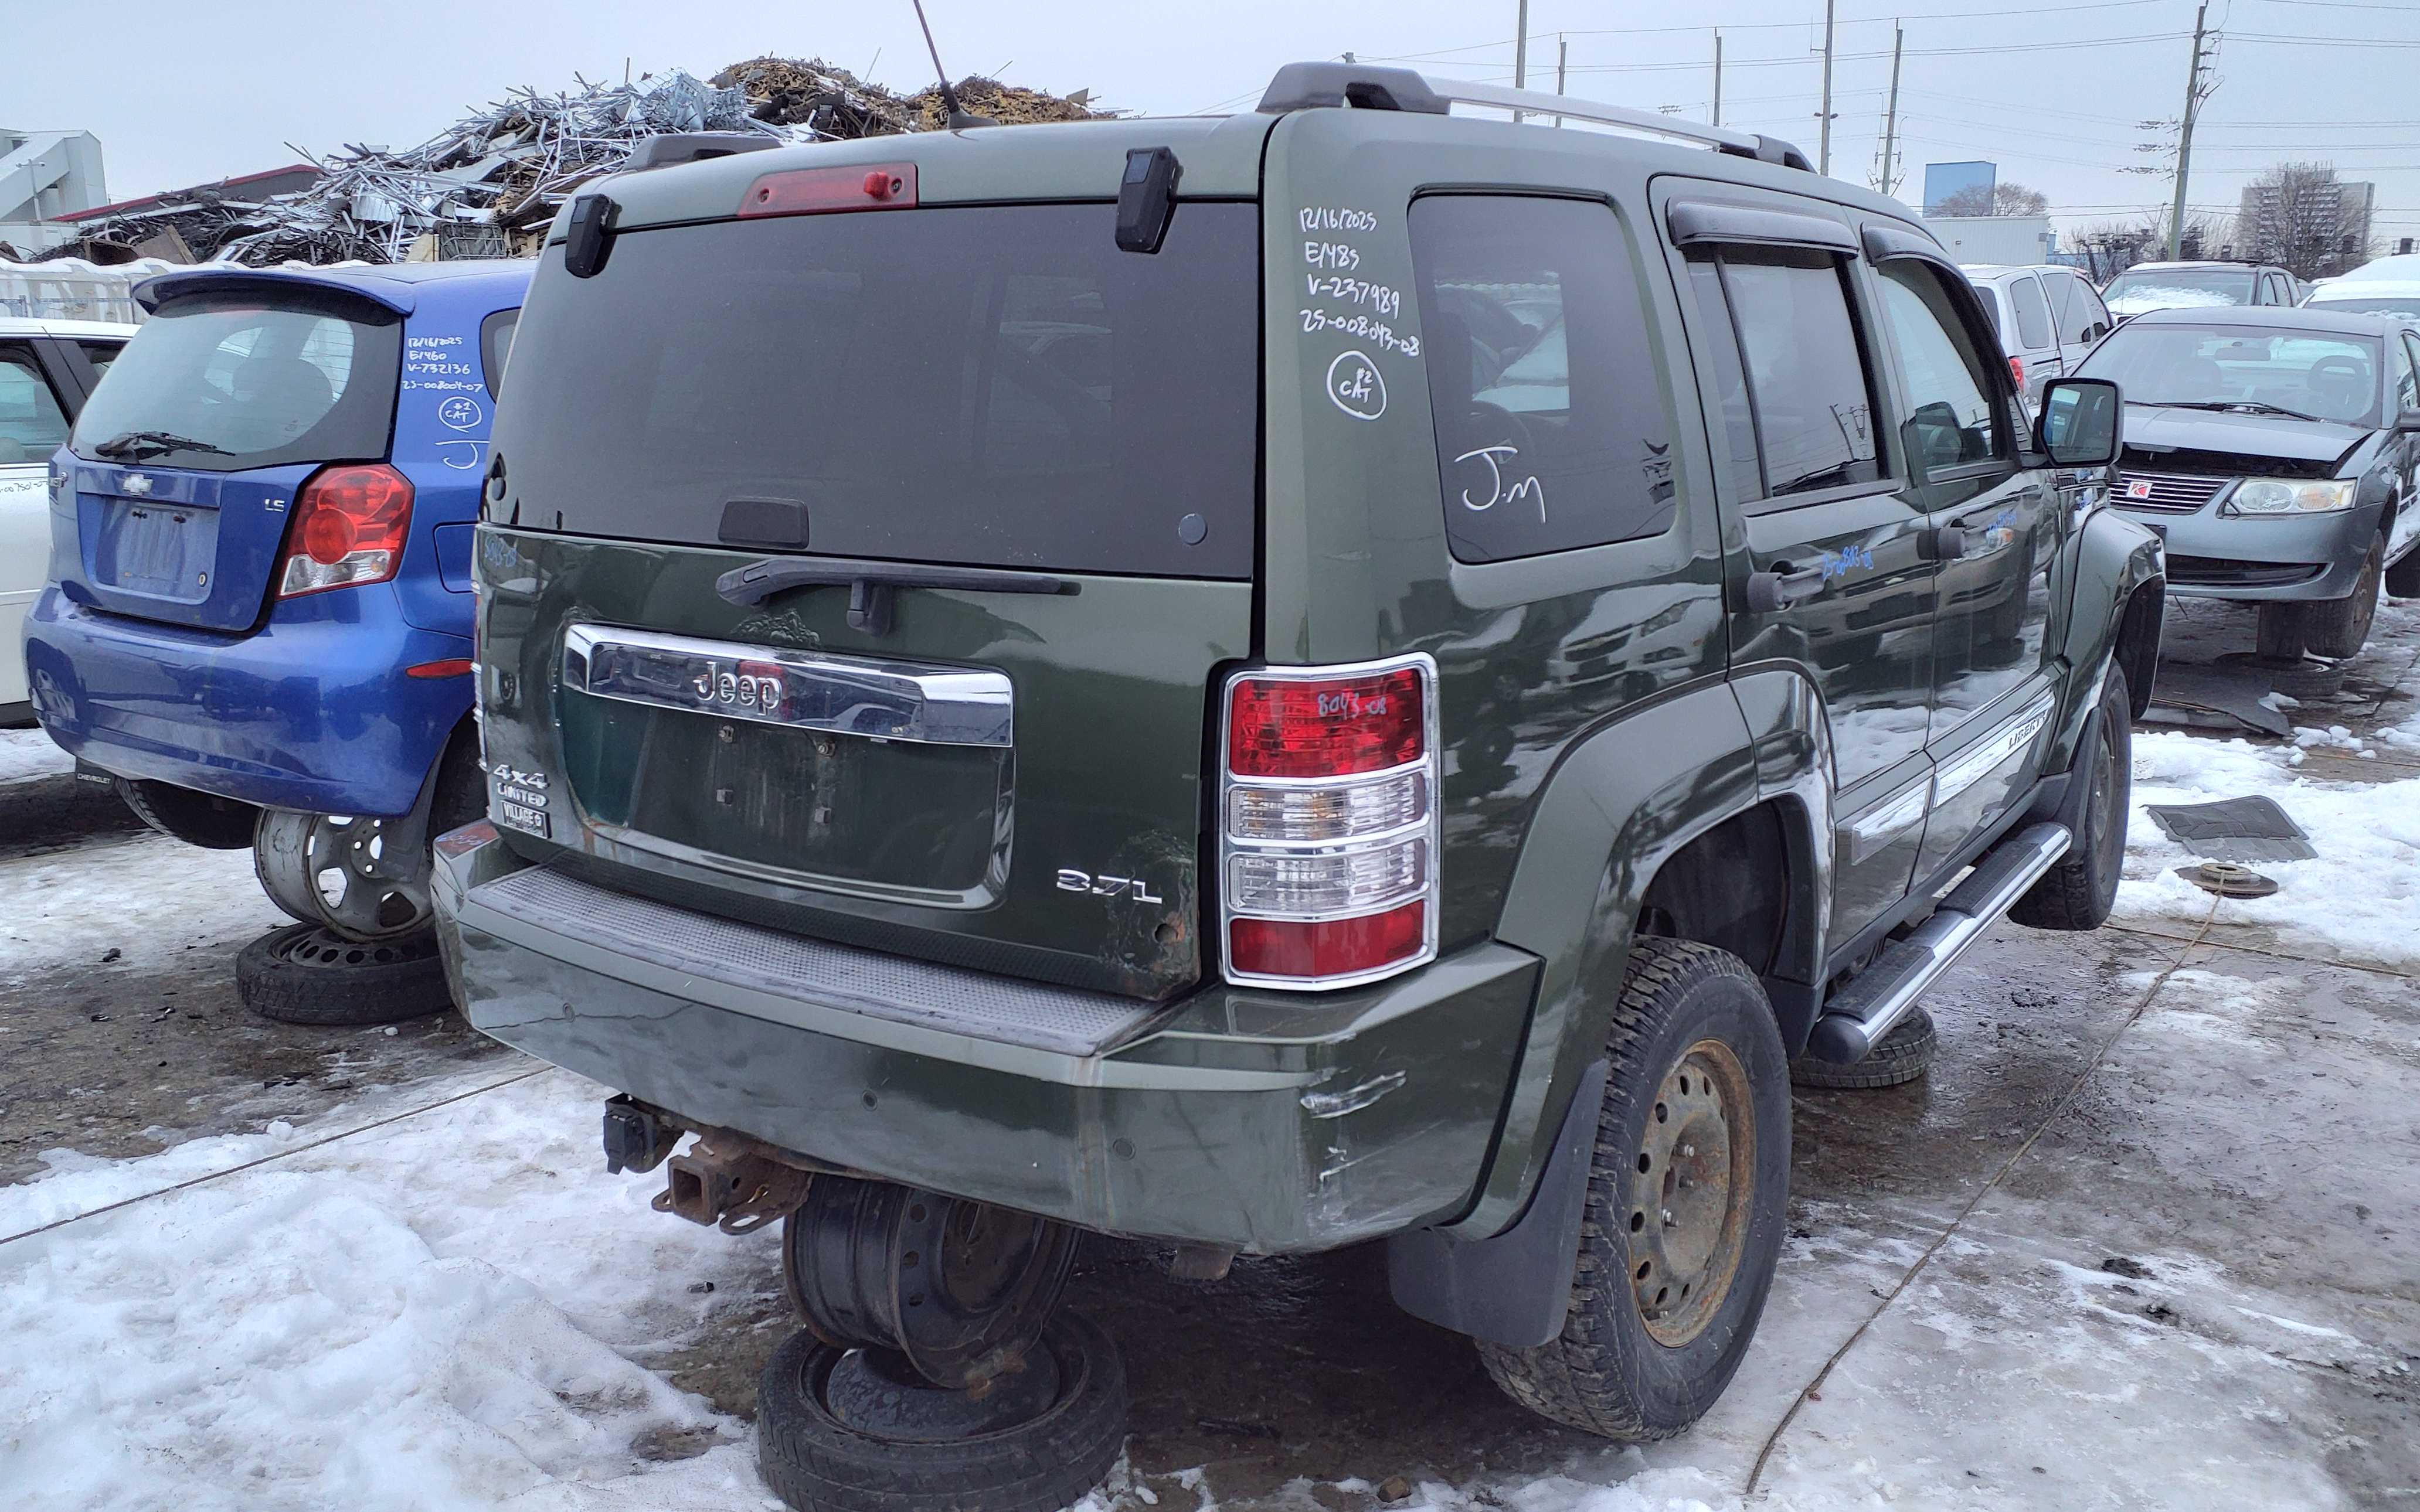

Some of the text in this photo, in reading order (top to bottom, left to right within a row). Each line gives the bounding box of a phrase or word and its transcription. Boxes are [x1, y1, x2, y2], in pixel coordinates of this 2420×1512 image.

[1307, 273, 1401, 319] V-237989
[1299, 309, 1420, 357] 25-008043-08
[407, 363, 470, 374] V-732136
[1339, 380, 1372, 403] CAT
[445, 410, 469, 423] CAT
[264, 499, 285, 512] LS
[693, 661, 783, 716] Jeep
[497, 782, 548, 807] LIMITED
[503, 803, 534, 825] VILLAGE
[1056, 869, 1163, 904] 3.7L
